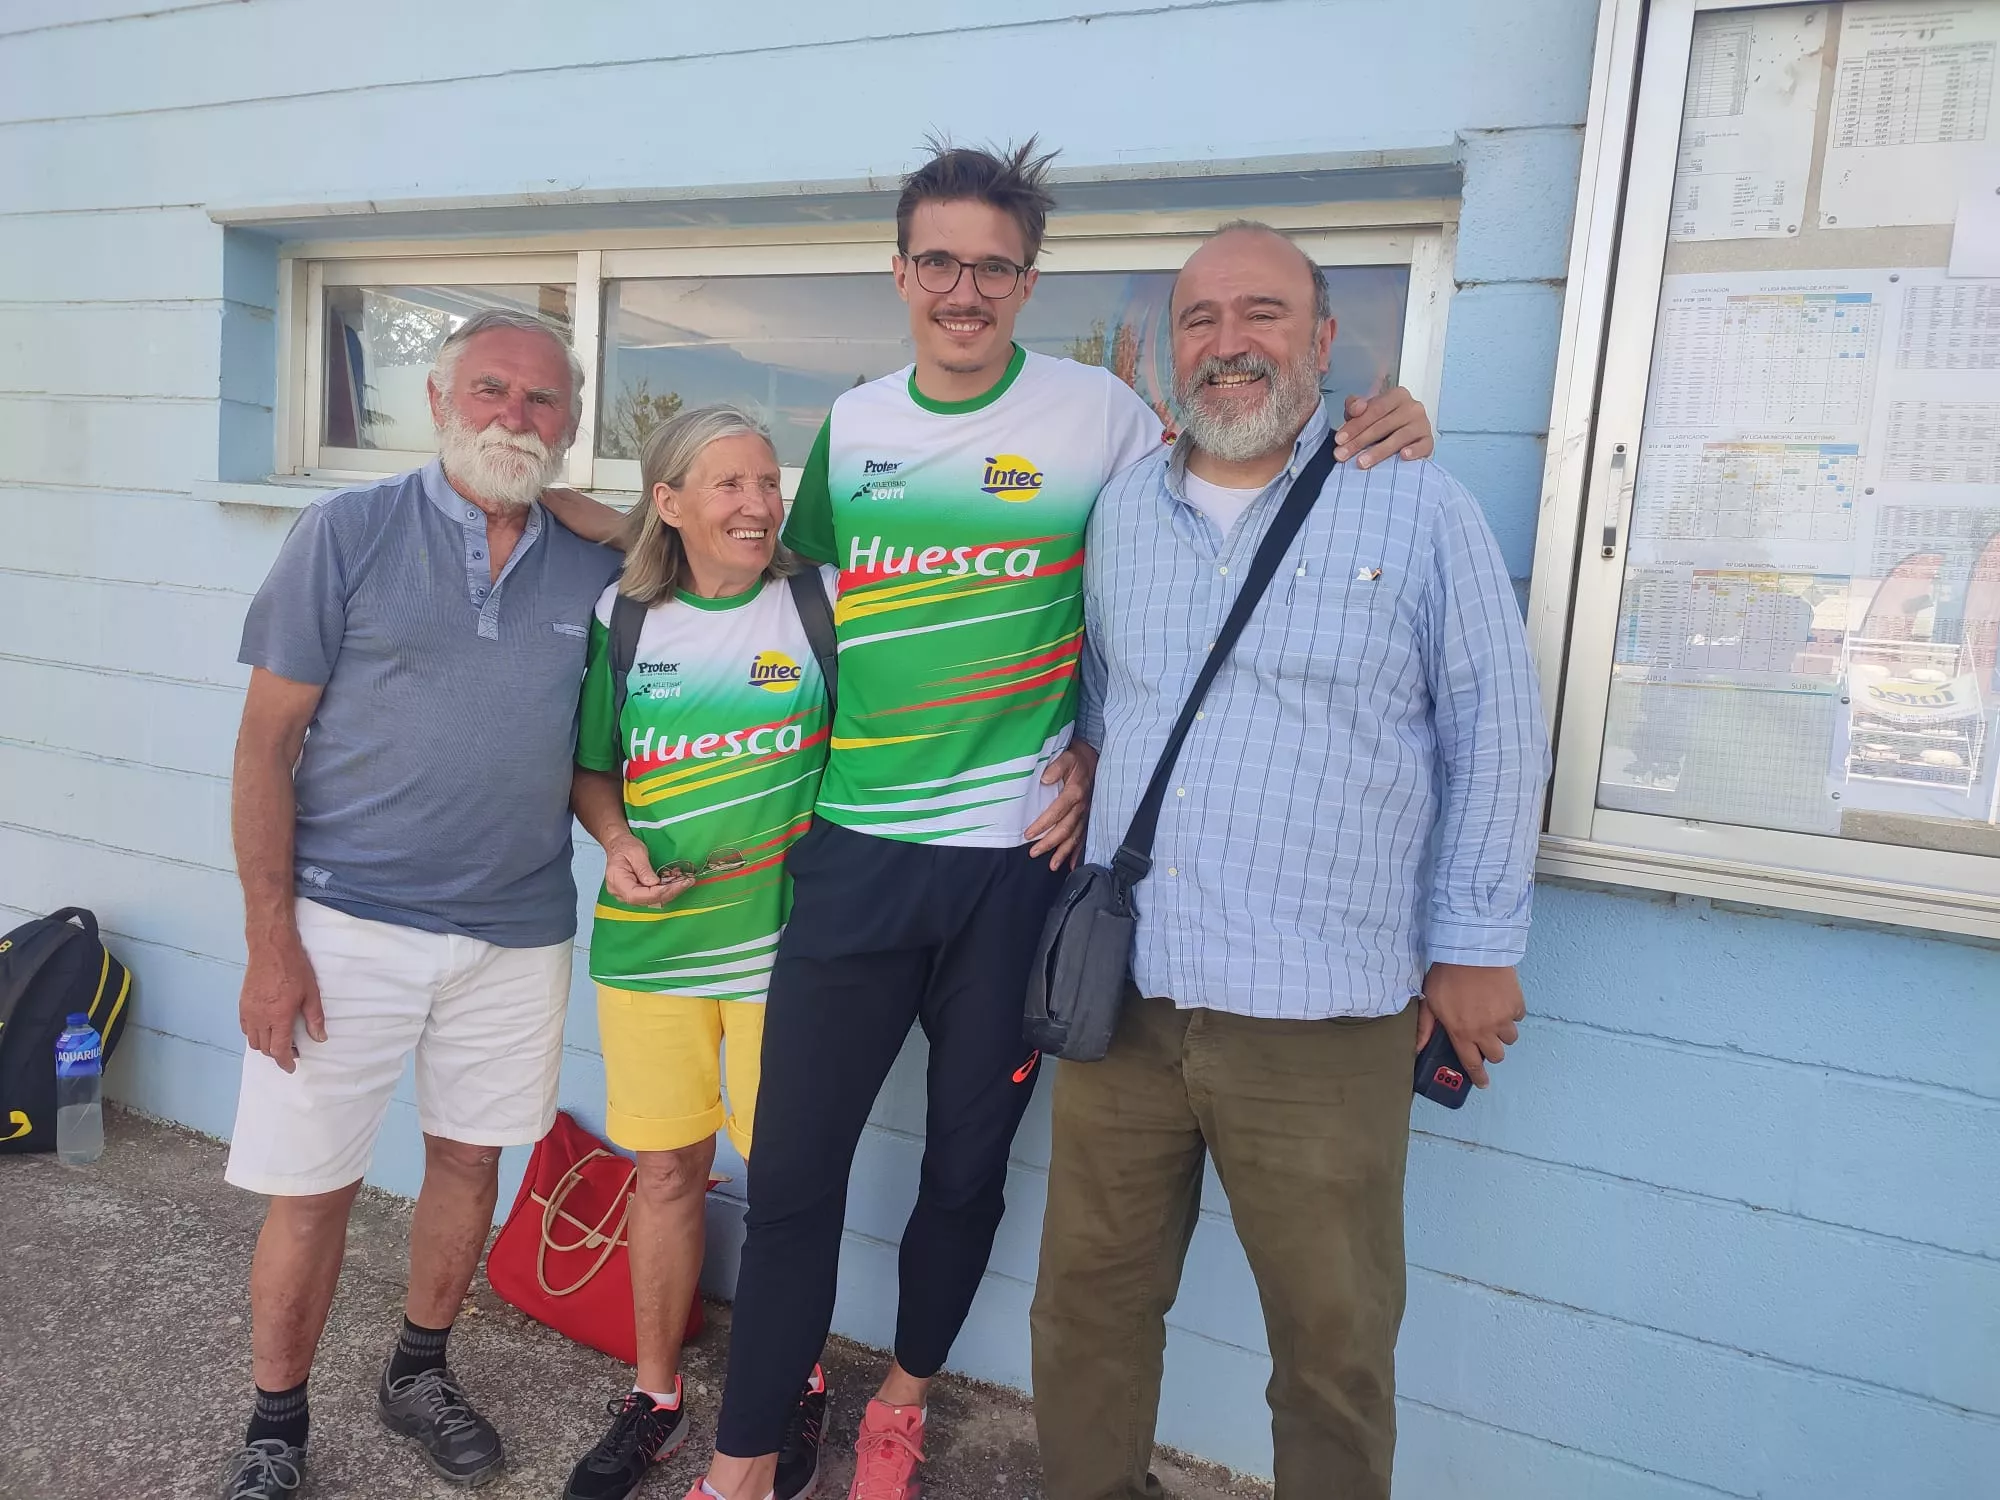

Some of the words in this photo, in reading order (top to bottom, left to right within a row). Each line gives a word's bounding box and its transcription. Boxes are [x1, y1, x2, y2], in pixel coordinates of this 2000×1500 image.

[863, 460, 903, 473] Protex
[849, 535, 1041, 577] Huesca
[637, 661, 681, 674] Protex
[630, 724, 802, 762] Huesca
